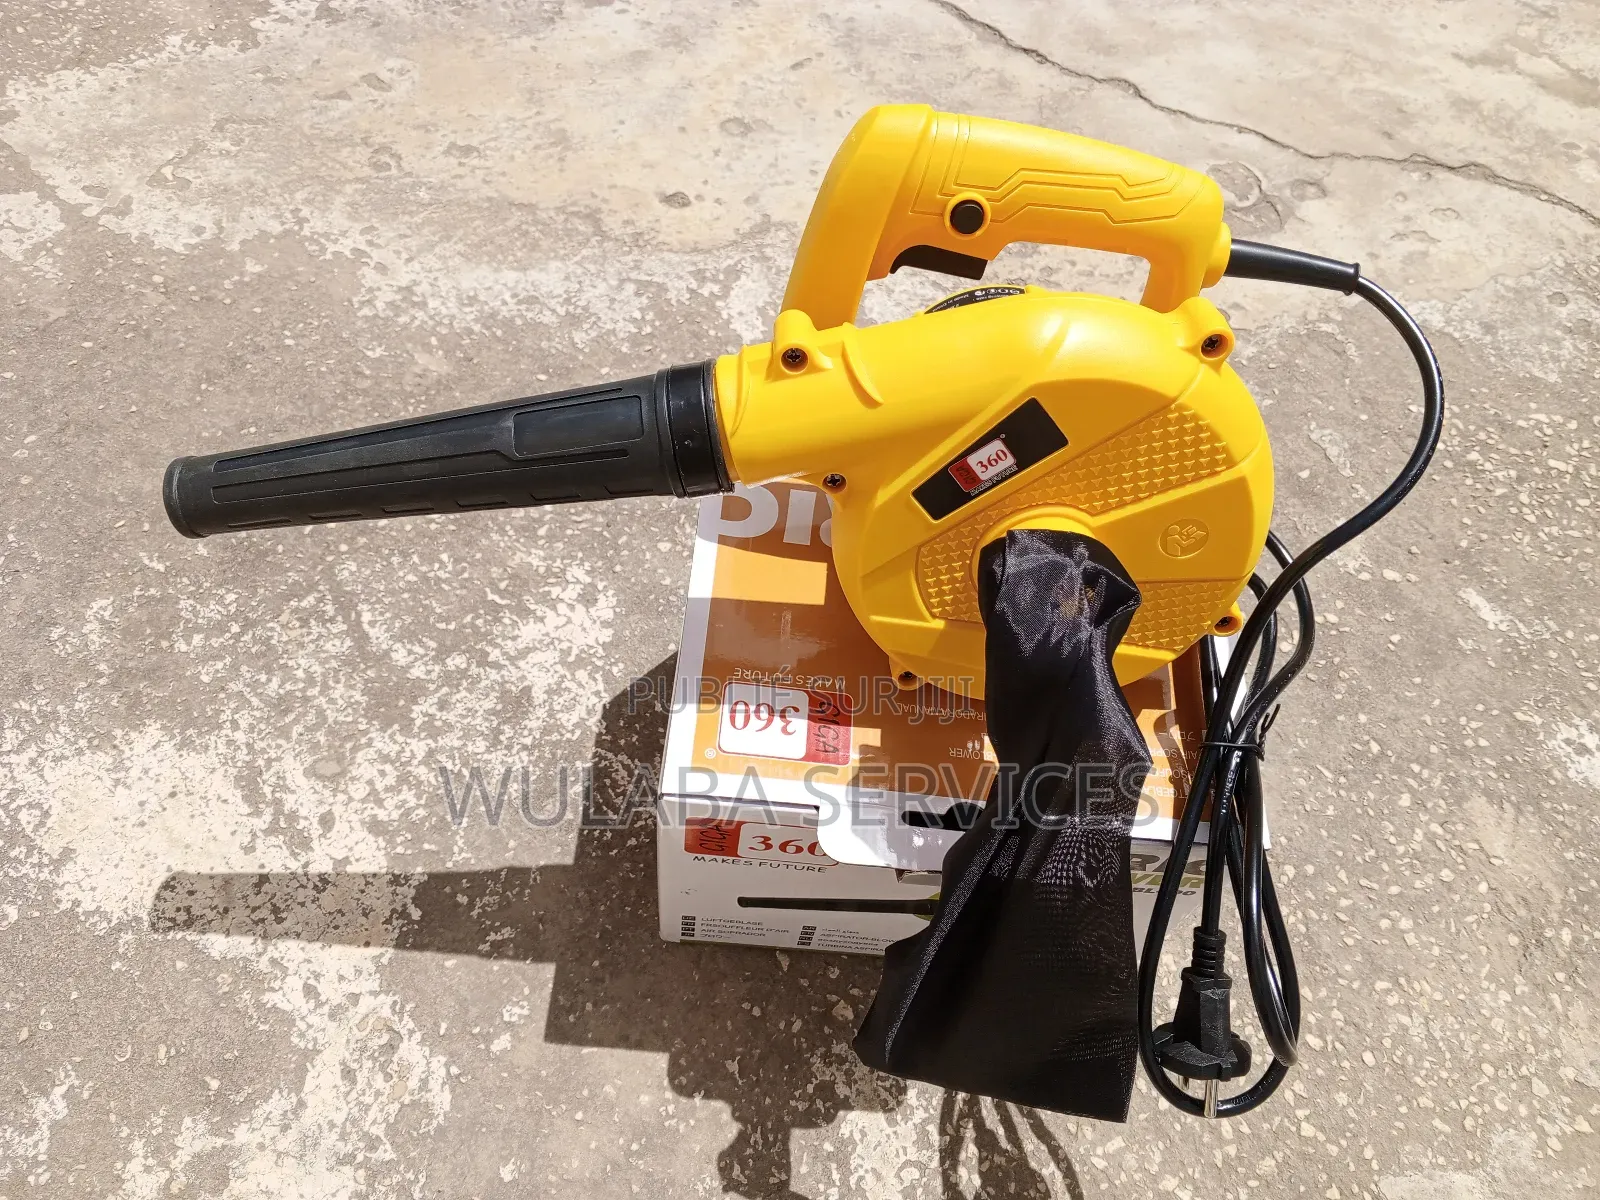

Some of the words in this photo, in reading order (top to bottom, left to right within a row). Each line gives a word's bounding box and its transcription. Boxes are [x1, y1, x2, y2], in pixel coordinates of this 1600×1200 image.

[976, 449, 1008, 474] 360
[733, 667, 793, 684] FUTURE
[796, 675, 846, 690] MAKES
[729, 700, 800, 736] 360
[692, 855, 753, 866] MAKES
[758, 861, 828, 874] FUTURE
